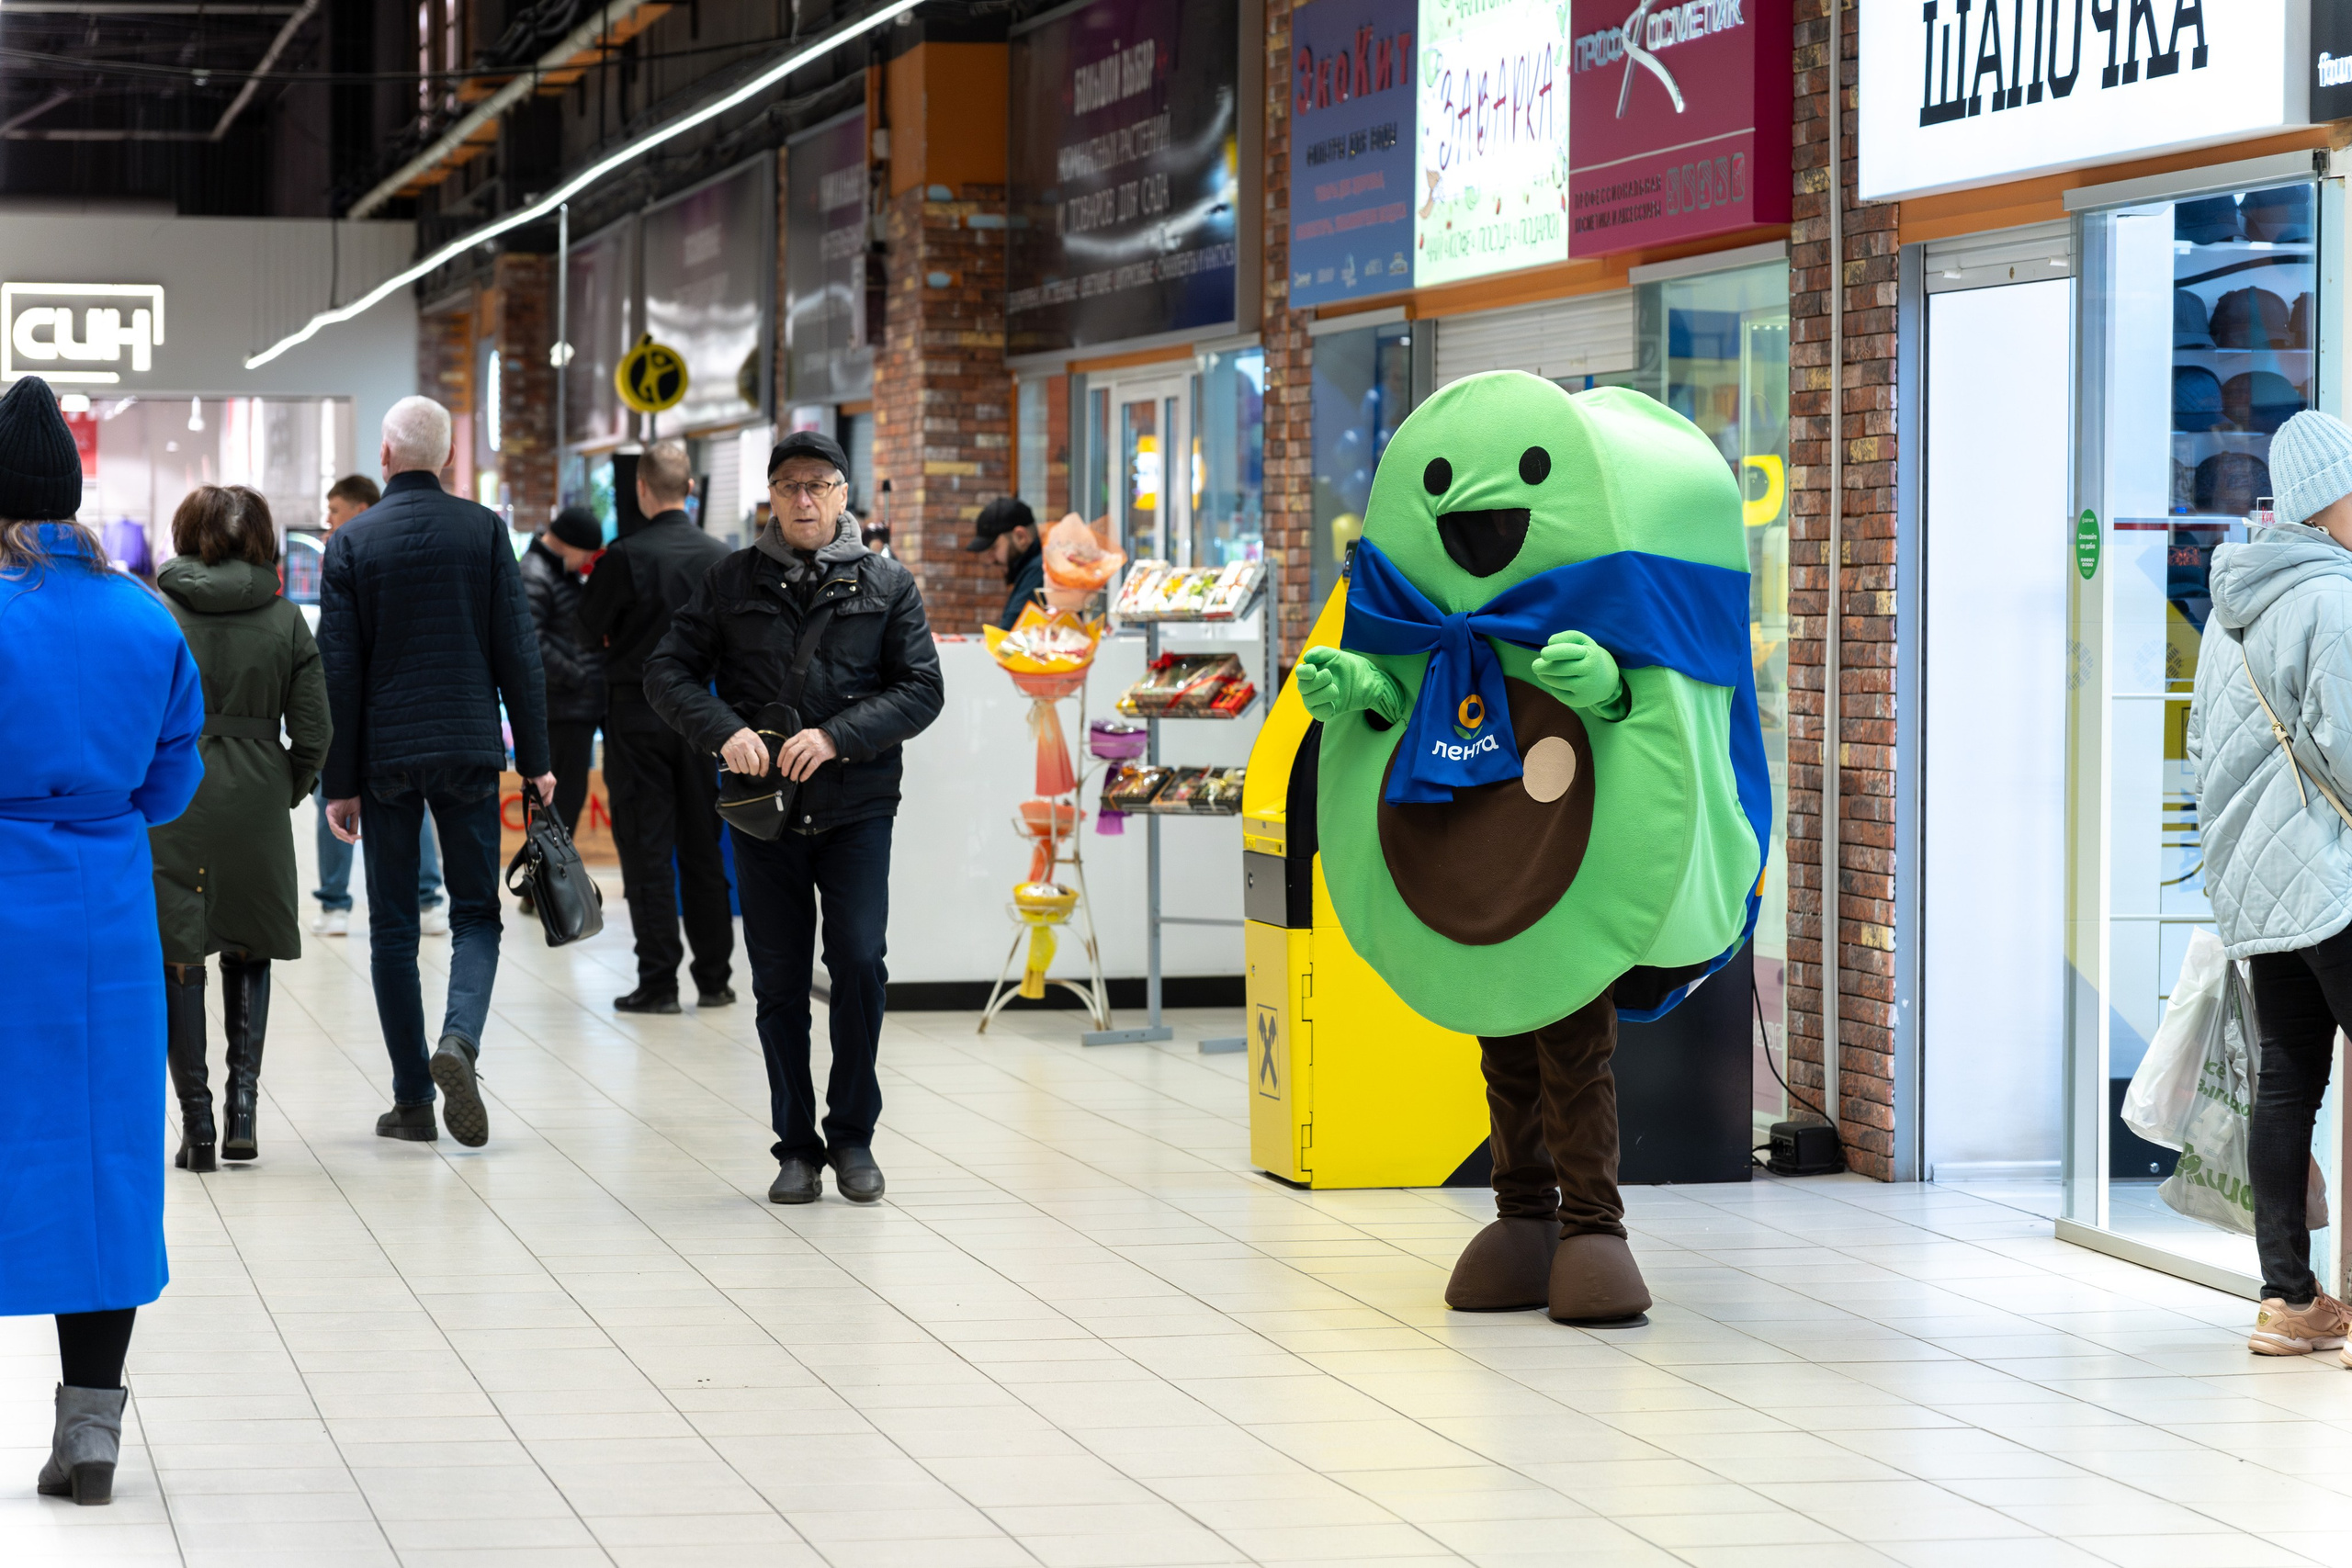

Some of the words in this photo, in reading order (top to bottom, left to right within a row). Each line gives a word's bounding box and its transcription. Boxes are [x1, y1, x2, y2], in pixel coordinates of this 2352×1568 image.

[1439, 42, 1553, 171] ЗАВАРКА
[1919, 0, 2209, 128] ШАПОЧКА
[1431, 734, 1499, 761] лента
